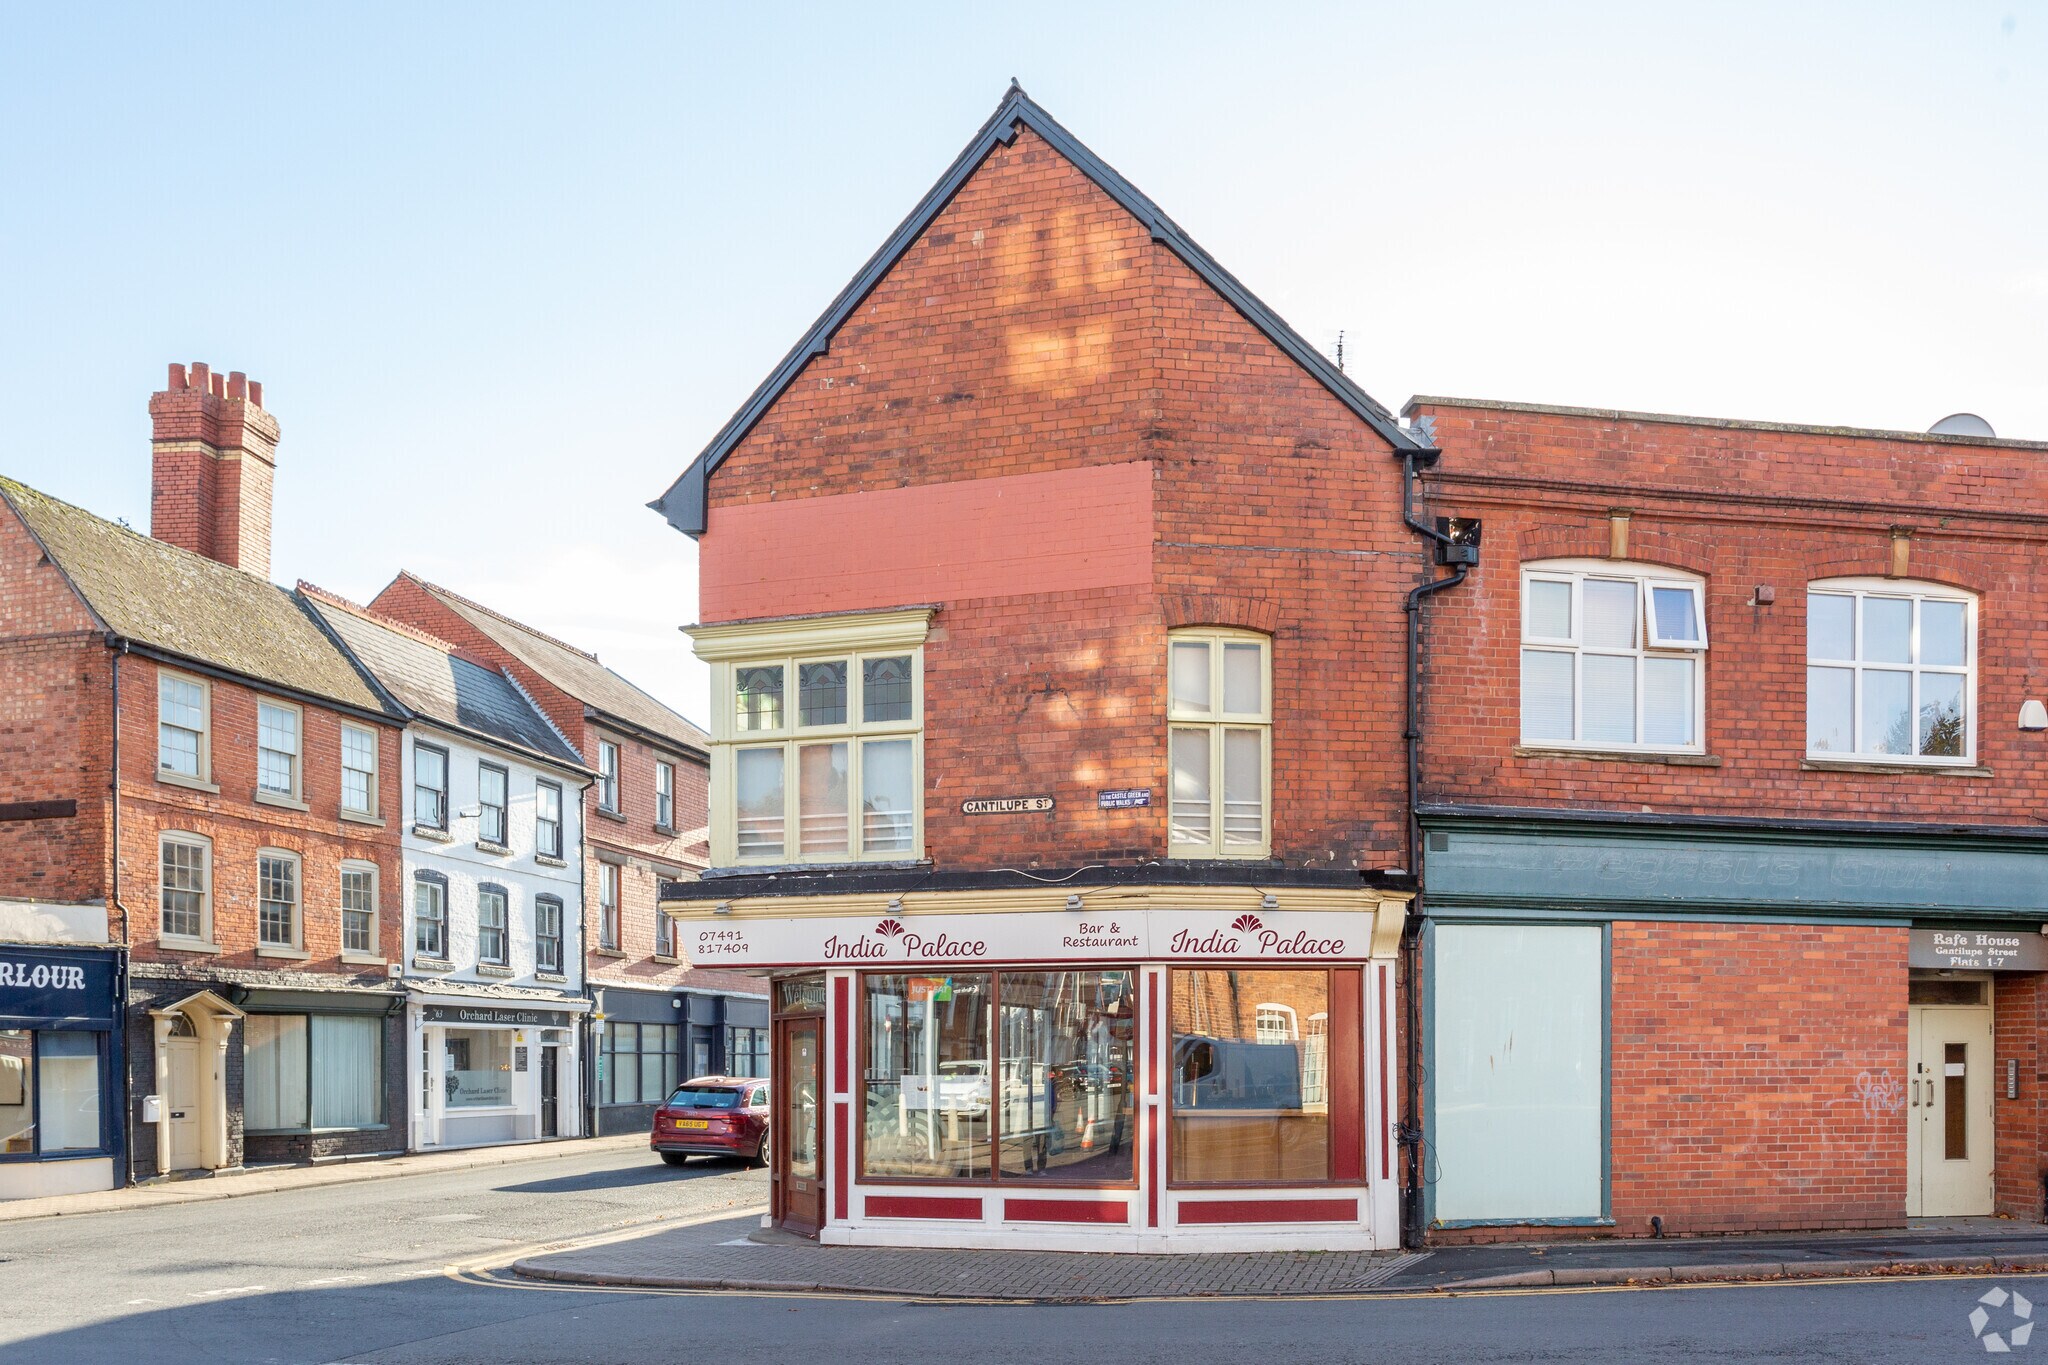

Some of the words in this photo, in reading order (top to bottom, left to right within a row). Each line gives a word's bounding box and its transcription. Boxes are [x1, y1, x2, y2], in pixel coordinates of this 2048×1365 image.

[966, 800, 1029, 812] CANTILUPE
[1079, 922, 1104, 934] Bar
[1109, 922, 1121, 934] &
[699, 931, 744, 942] 07491
[1063, 935, 1139, 948] Restaurant
[1170, 928, 1242, 954] India
[1258, 929, 1346, 955] Palace
[1933, 933, 1968, 947] Rafe
[1975, 934, 2020, 947] House
[698, 942, 749, 954] 817409
[824, 933, 889, 959] India
[902, 933, 987, 958] Palace
[1935, 946, 1983, 957] Cantilupe
[1987, 947, 2018, 957] Street
[1950, 956, 1980, 967] Flats
[1987, 957, 2005, 967] 1-7
[0, 962, 86, 990] RLOUR
[911, 985, 932, 995] JUST
[933, 985, 948, 994] EAT
[459, 1009, 493, 1022] Orchard
[495, 1011, 515, 1023] Laser
[516, 1012, 538, 1024] Clinic
